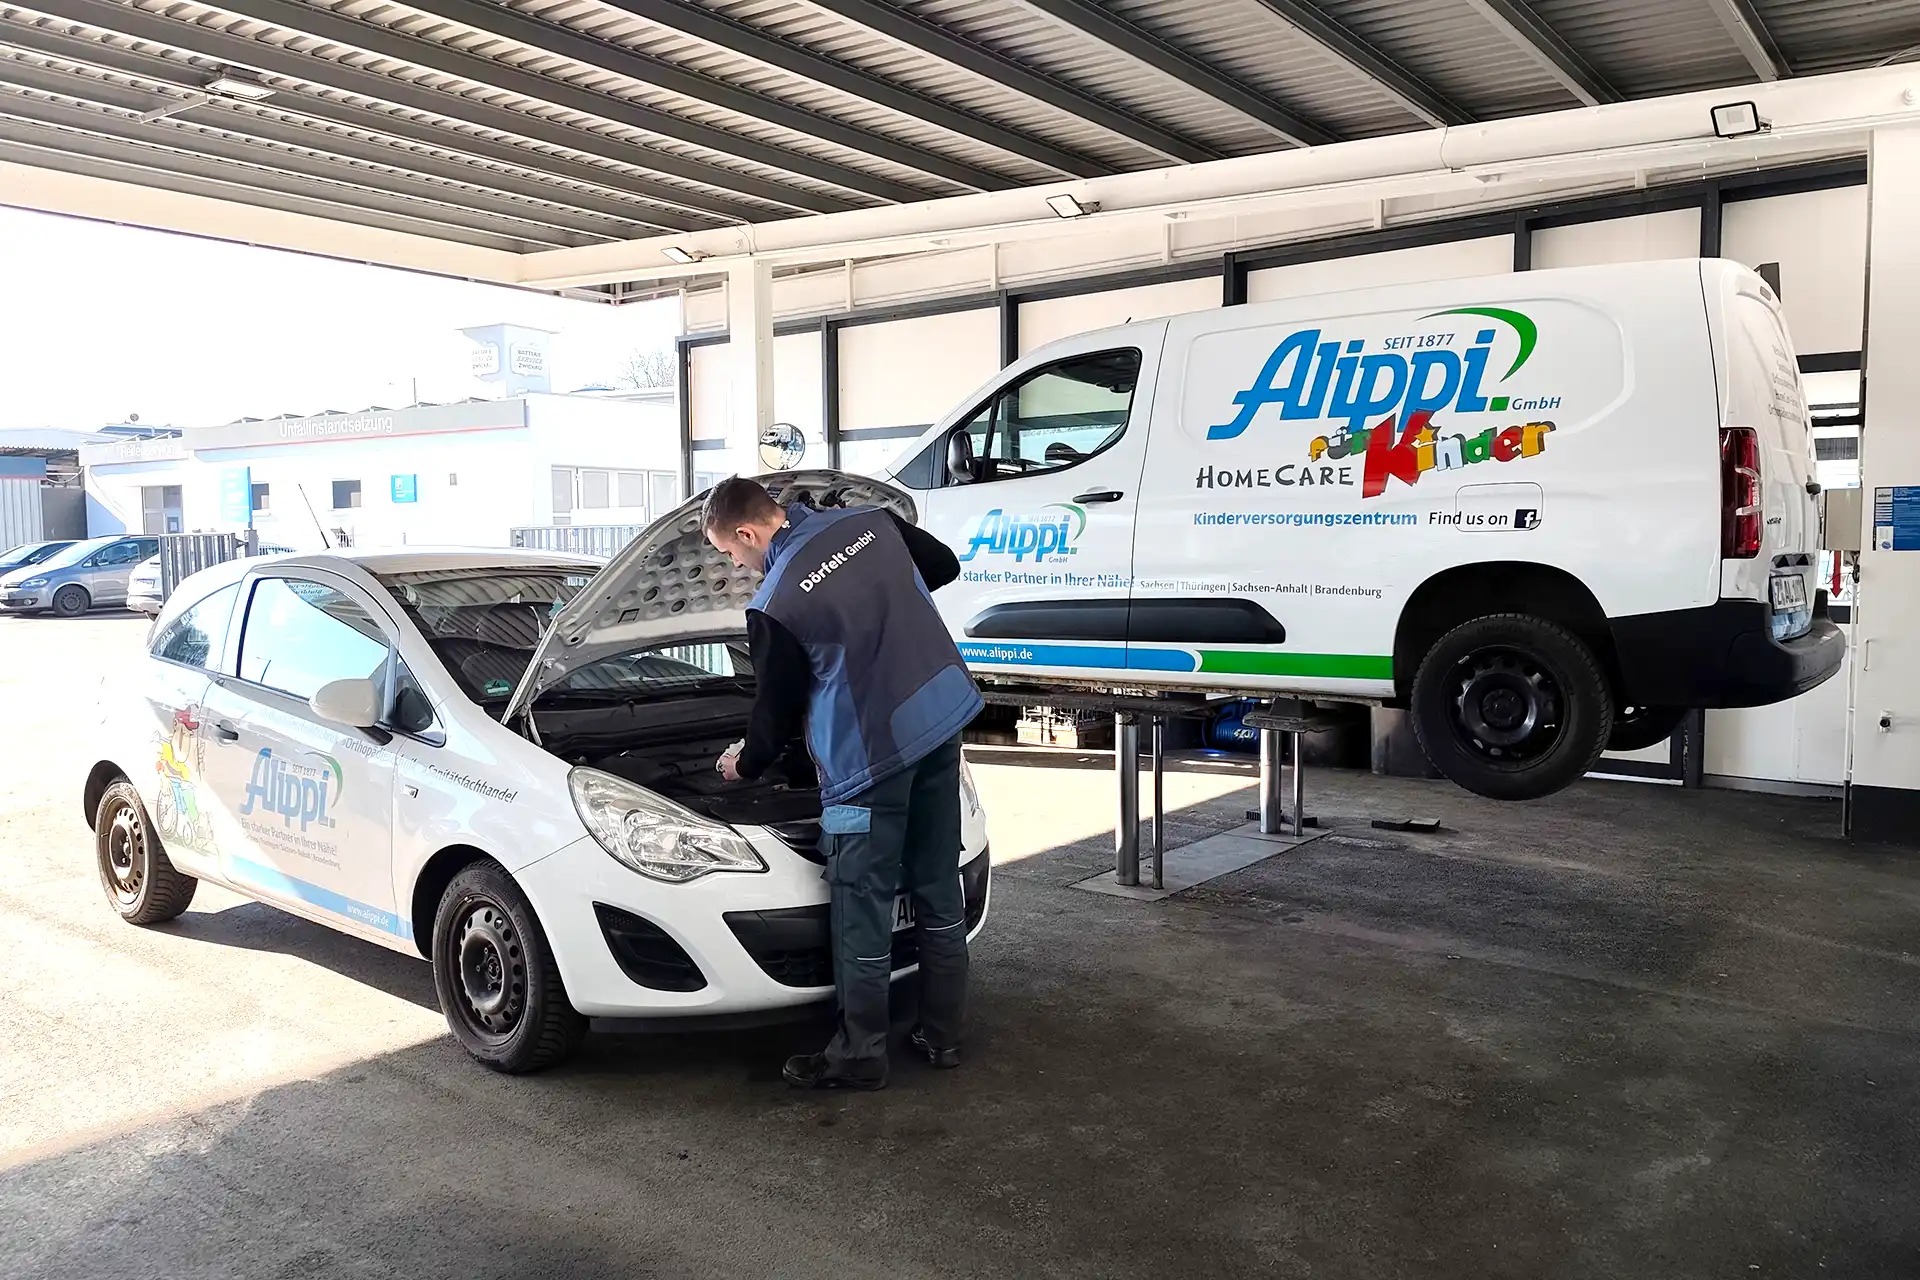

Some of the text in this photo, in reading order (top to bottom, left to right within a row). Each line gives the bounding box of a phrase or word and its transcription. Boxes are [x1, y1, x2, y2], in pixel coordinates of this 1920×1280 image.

[1383, 333, 1455, 350] SEIT 1877
[1512, 397, 1561, 411] GmbH
[280, 416, 393, 438] Unfallinstandsetzung
[1362, 409, 1556, 498] Kinder
[1193, 511, 1418, 528] Kinderversorgungszentrum
[1429, 511, 1461, 525] Find
[1466, 514, 1484, 525] us
[1489, 514, 1508, 525] on
[799, 530, 876, 593] Dörfelt GmbH
[964, 570, 1001, 582] starker
[1004, 571, 1048, 585] Partner
[1050, 573, 1062, 585] in
[1065, 573, 1095, 587] Ihrer
[1232, 582, 1308, 594] Sachsen-Anhalt
[1315, 584, 1382, 599] Brandenburg
[961, 646, 1033, 661] www.alippi.de
[428, 764, 519, 804] Sanitätsfachhandel
[346, 903, 390, 927] www.alippi.de
